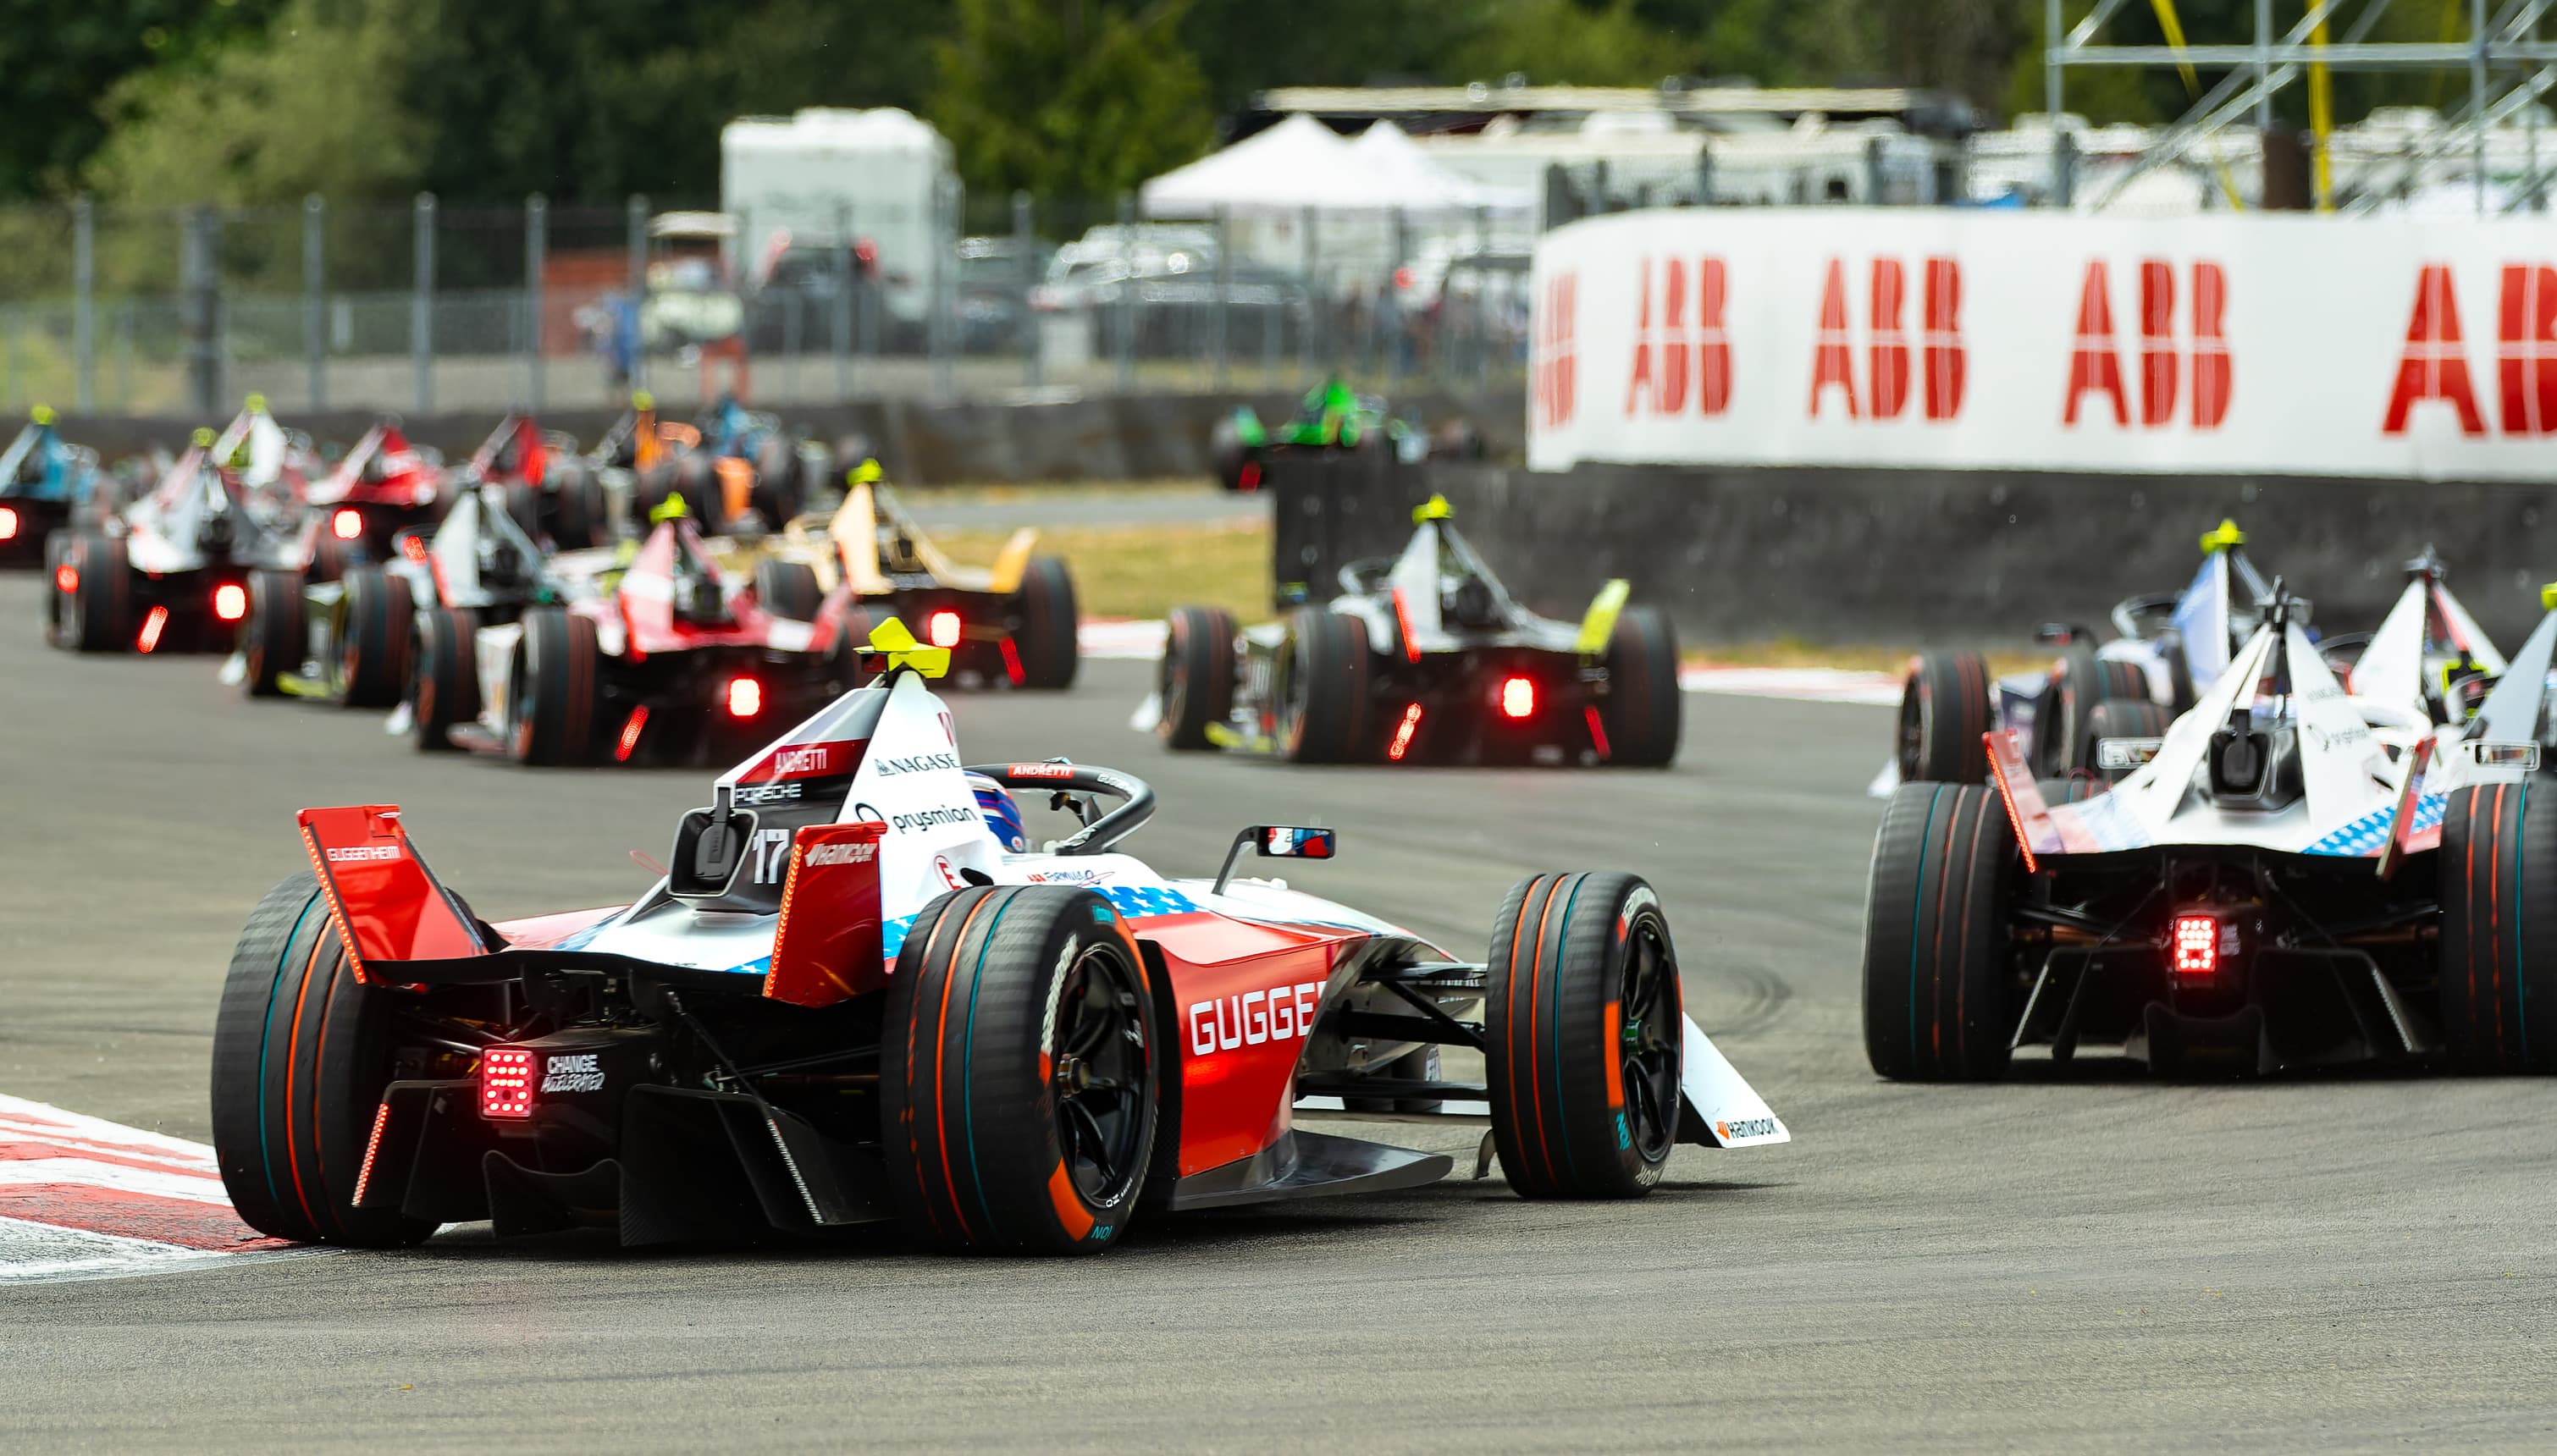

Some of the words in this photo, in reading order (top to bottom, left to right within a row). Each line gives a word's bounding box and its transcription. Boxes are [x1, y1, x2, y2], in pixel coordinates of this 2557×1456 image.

[1626, 256, 1733, 415] ABB
[1807, 256, 1968, 422] ABB
[2063, 260, 2234, 428] ABB
[774, 748, 827, 774] ANDRETTI
[888, 753, 963, 774] NAGASE
[1013, 764, 1071, 776] ANDRETTI
[735, 783, 802, 802] PORSCHE
[892, 804, 979, 835] prysmian
[326, 846, 401, 862] GUGGENHEIM
[753, 829, 790, 884] 17
